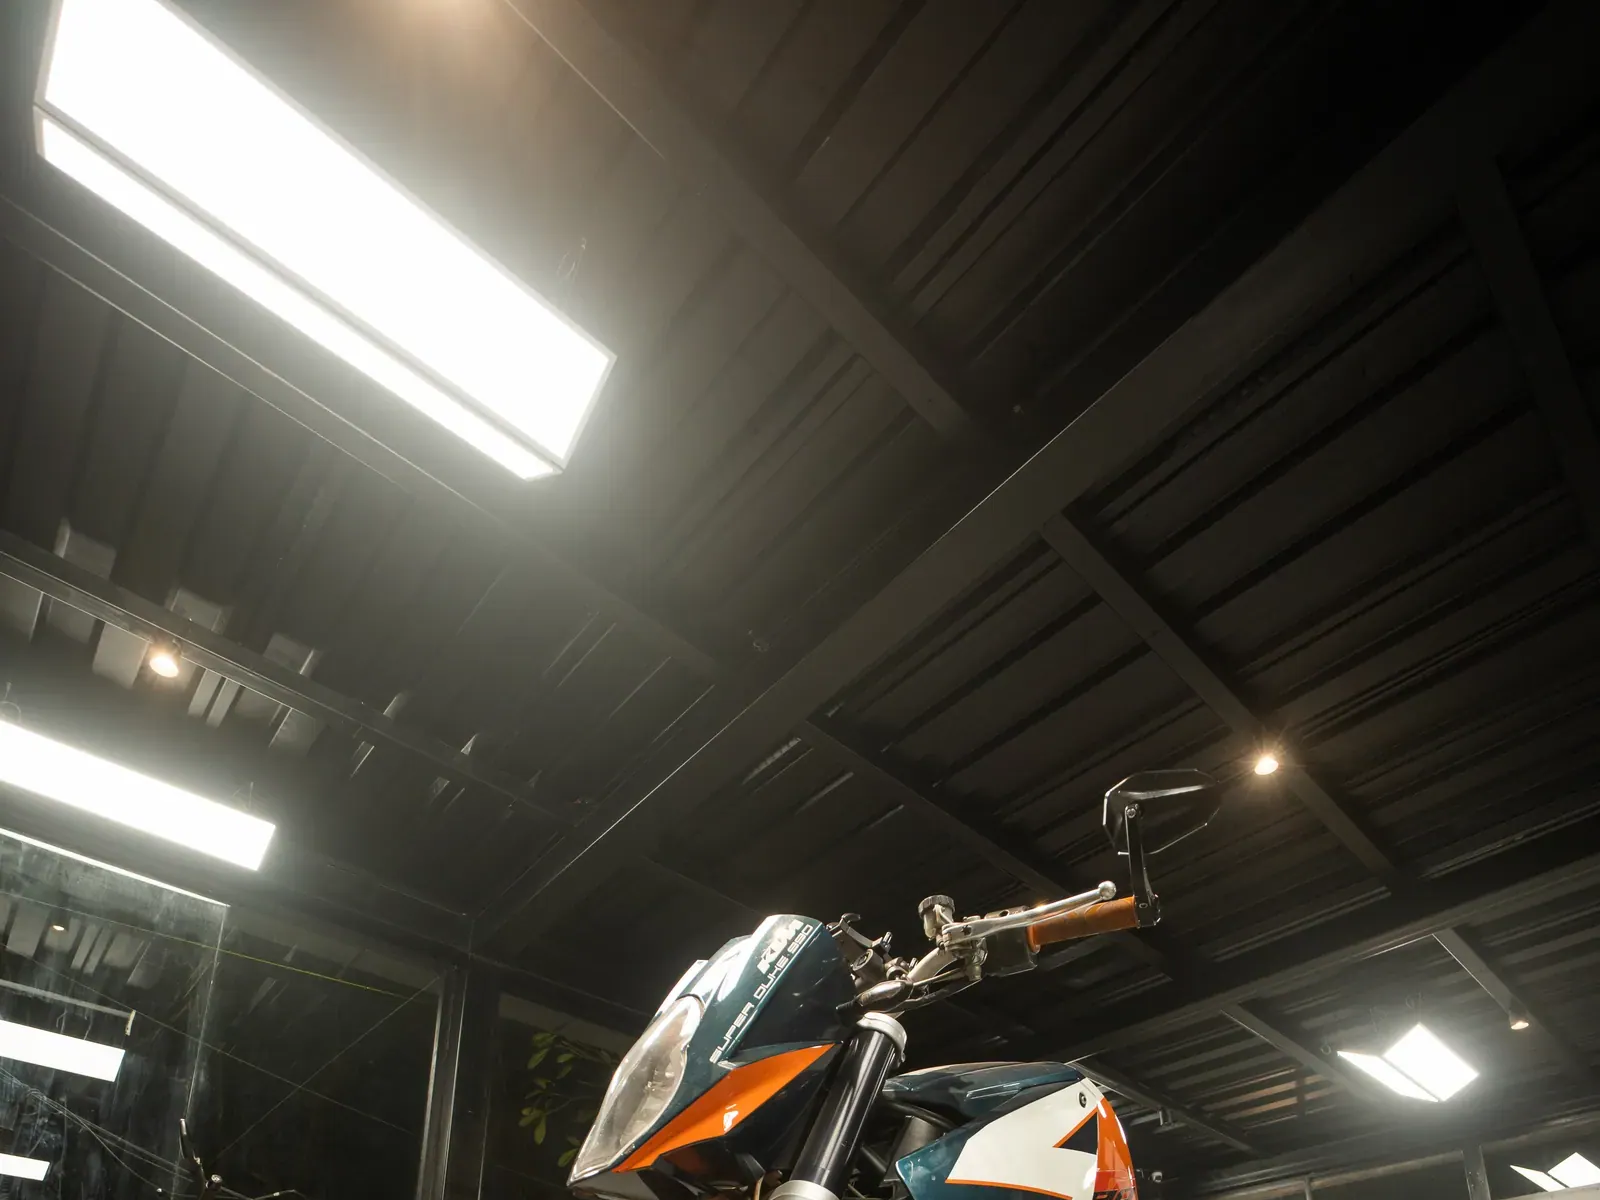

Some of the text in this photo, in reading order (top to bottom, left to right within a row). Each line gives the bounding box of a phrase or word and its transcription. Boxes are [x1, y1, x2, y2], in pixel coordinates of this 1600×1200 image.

[709, 923, 814, 1064] SUPER DUKE 990
[756, 918, 804, 975] KTM
